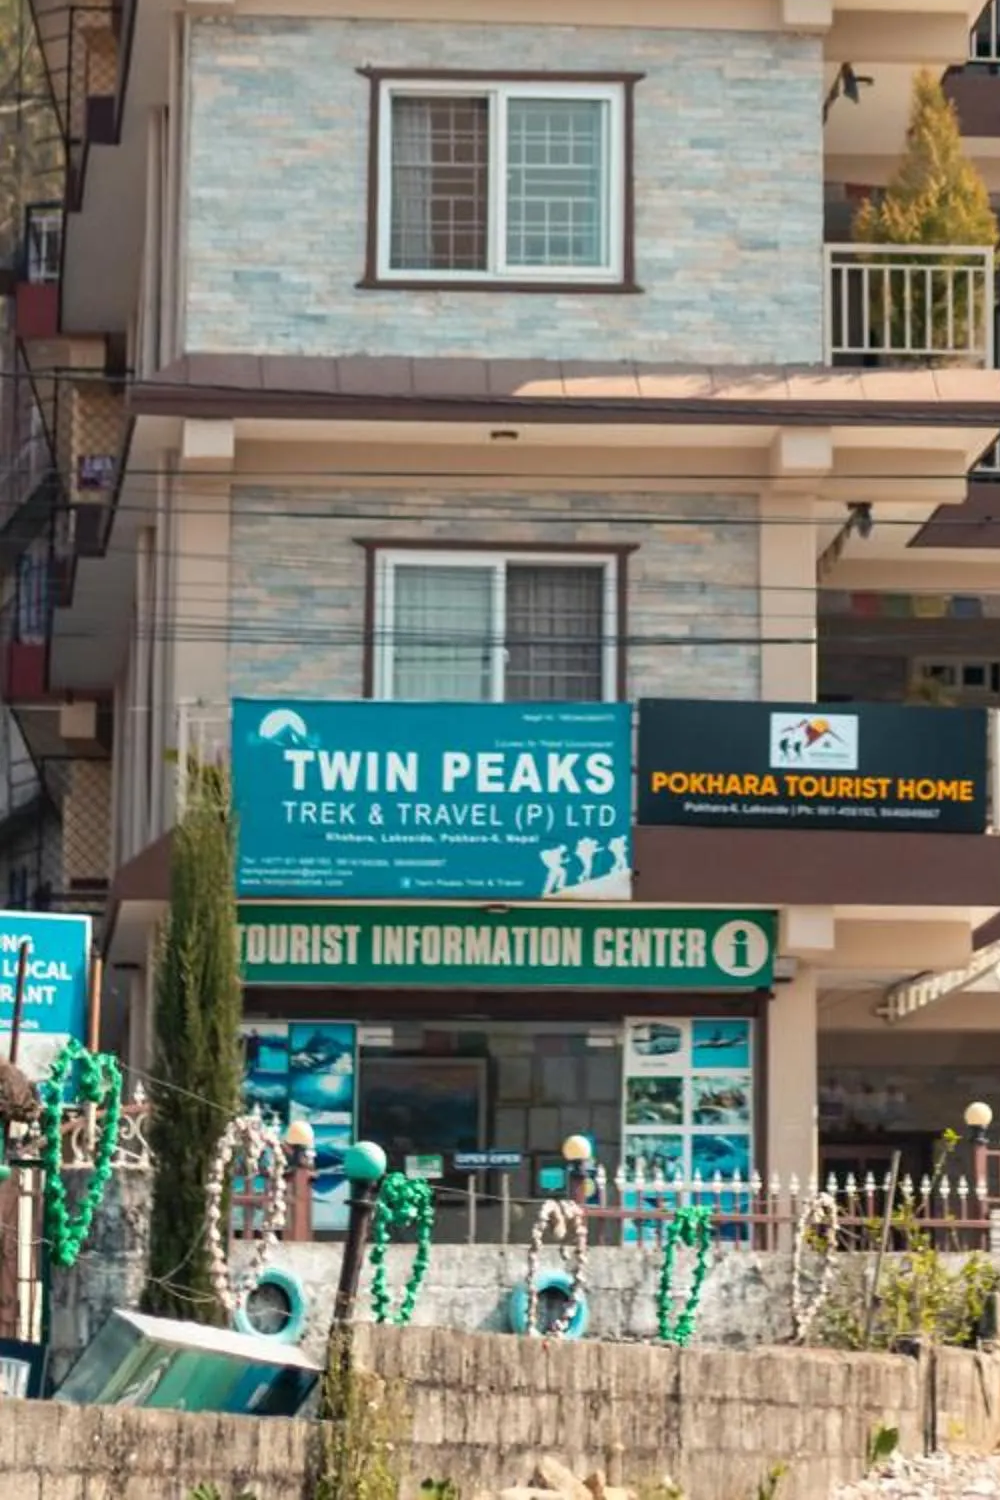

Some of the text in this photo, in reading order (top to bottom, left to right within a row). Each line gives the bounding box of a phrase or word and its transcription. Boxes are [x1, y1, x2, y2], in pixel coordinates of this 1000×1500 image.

[284, 750, 615, 794] TWIN PEAKS
[652, 771, 974, 802] POKHARA TOURIST HOME
[282, 801, 617, 831] TREK & TRAVEL (P) LTD
[371, 925, 582, 967] INFORMATION
[593, 927, 707, 968] CENTER
